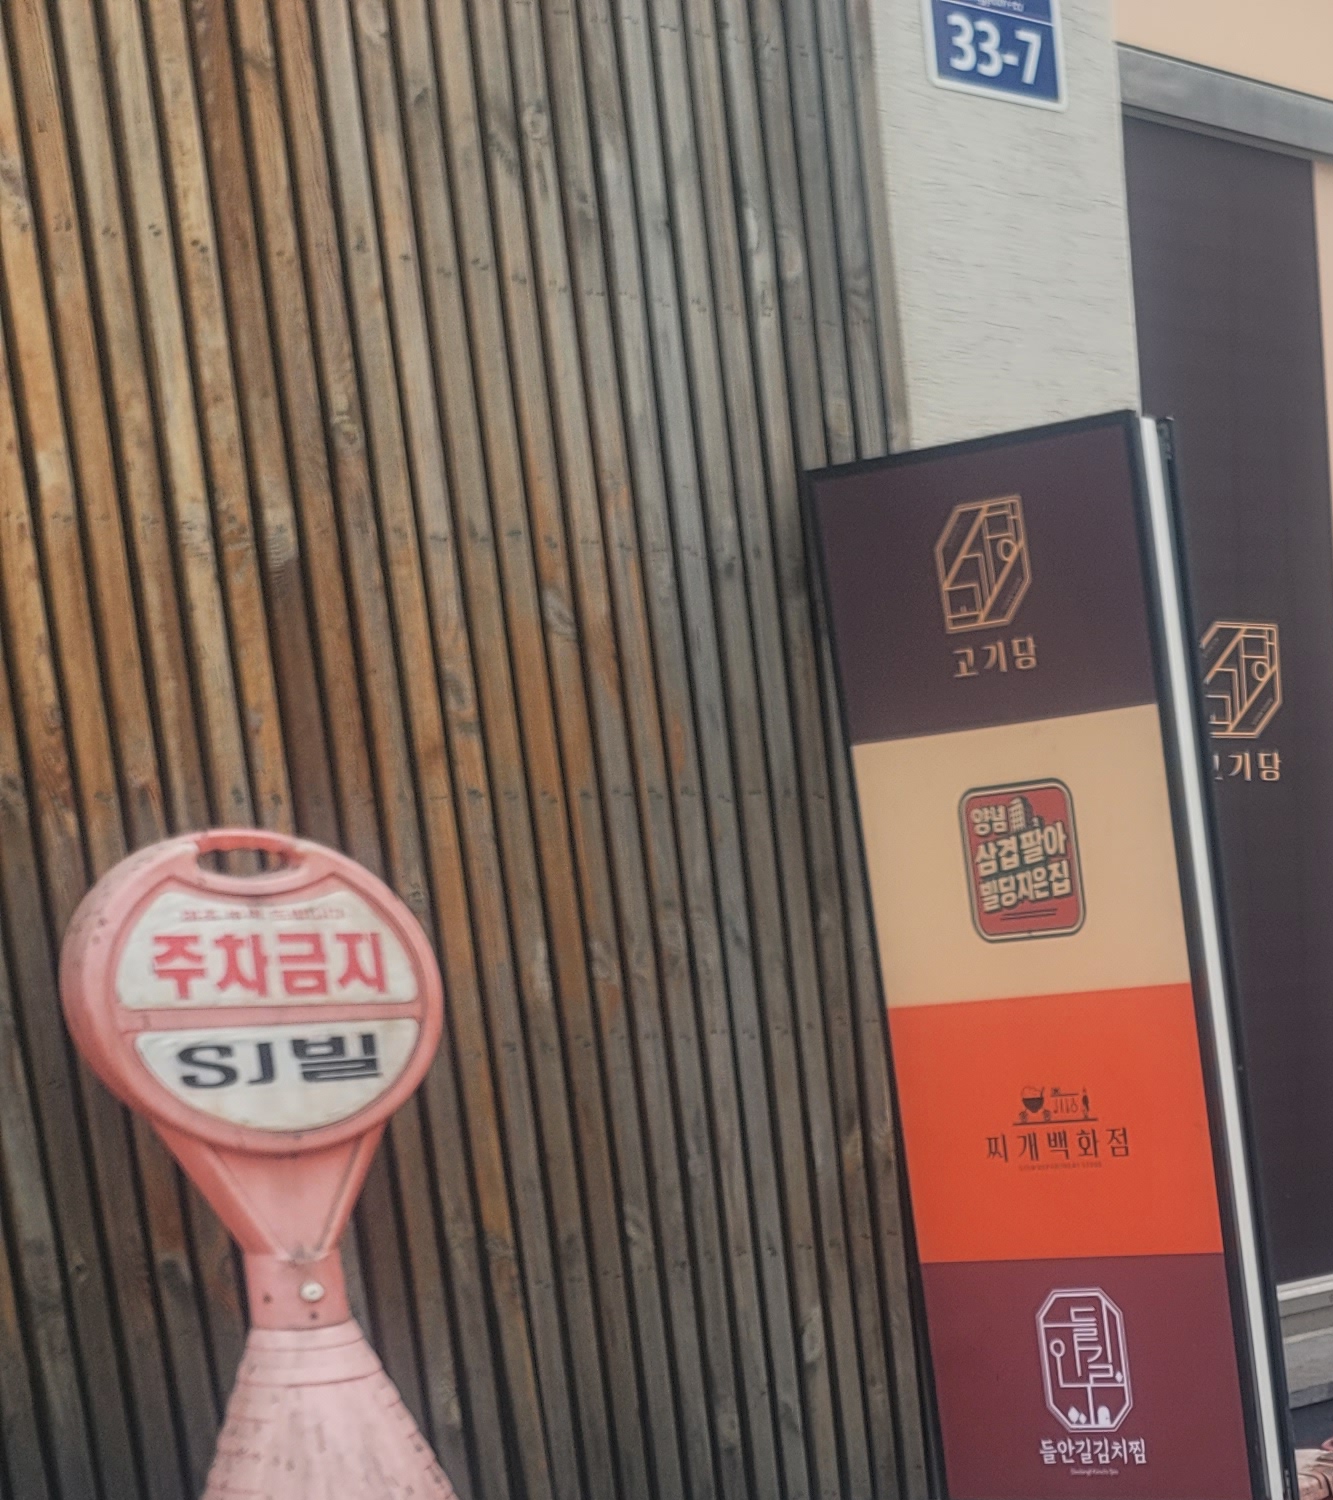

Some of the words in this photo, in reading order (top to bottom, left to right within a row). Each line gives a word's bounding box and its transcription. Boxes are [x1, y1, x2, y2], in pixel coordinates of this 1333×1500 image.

[947, 13, 1042, 85] 33-7
[953, 635, 1038, 678] 고기당
[970, 803, 1008, 836] 양념
[151, 931, 388, 1000] 주차금지
[176, 1034, 384, 1089] SJ빌
[985, 1126, 1131, 1164] 찌개백화점
[1039, 1437, 1147, 1465] 들안길김치찜
